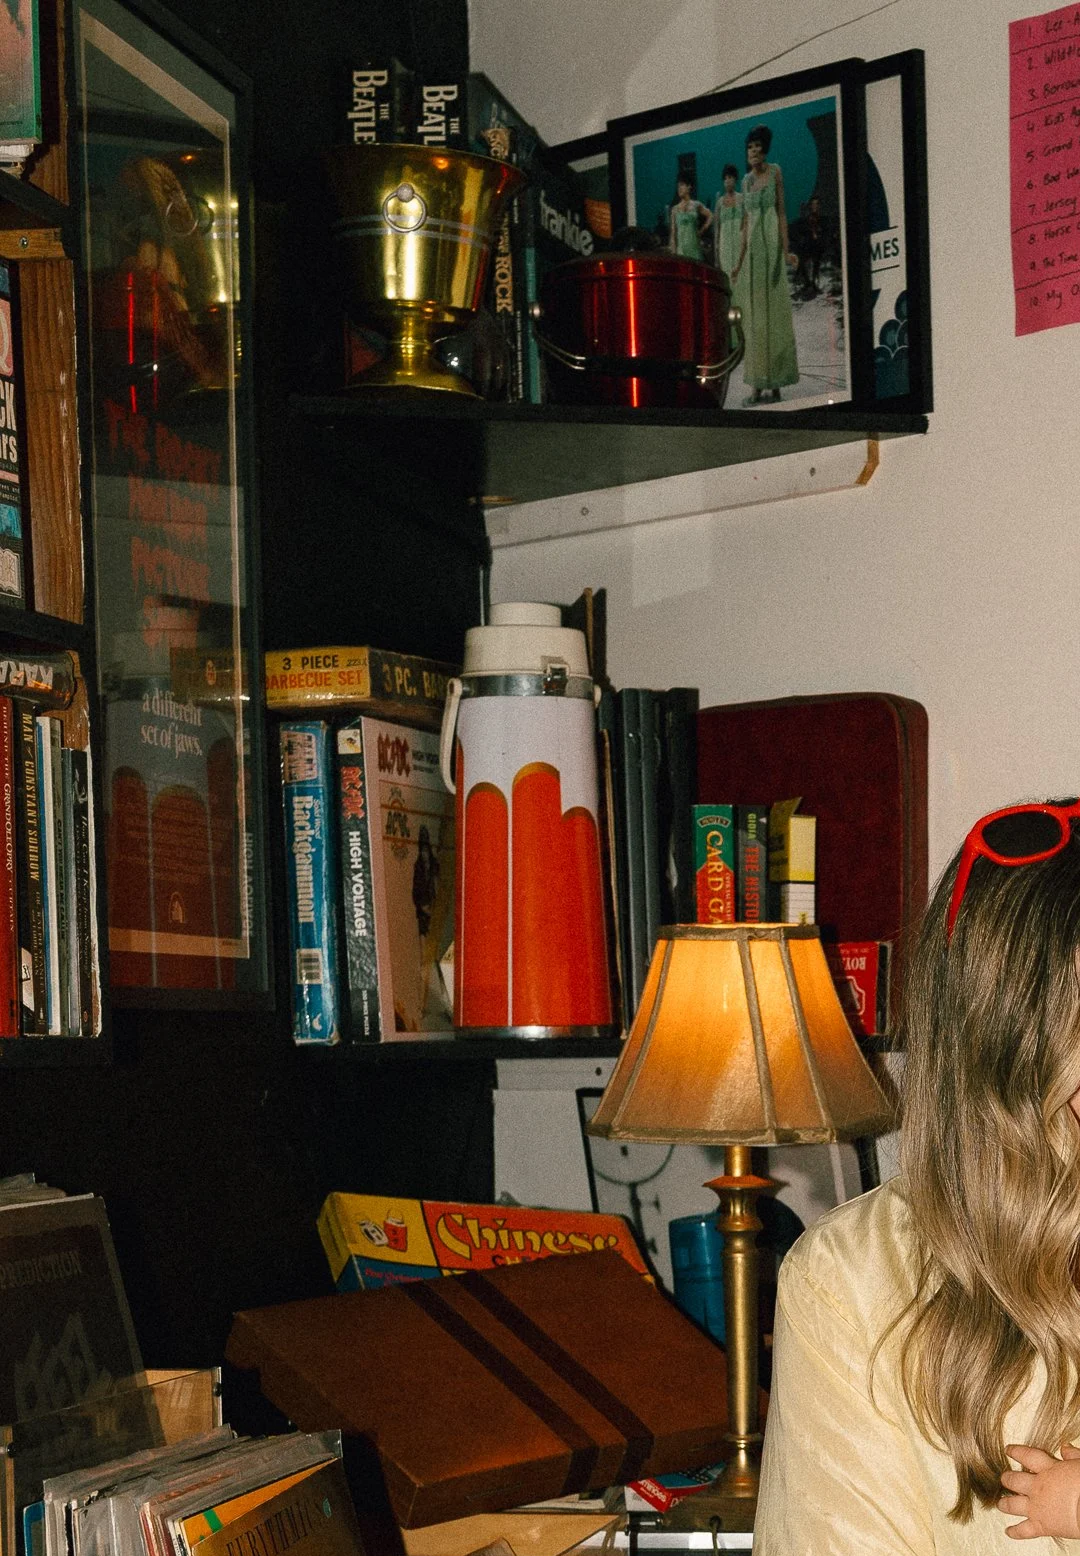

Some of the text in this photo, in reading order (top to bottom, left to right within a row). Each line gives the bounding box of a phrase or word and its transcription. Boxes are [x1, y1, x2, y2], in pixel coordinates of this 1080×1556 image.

[380, 103, 390, 120] THE
[450, 117, 461, 134] THE
[1043, 139, 1073, 158] Grand
[1043, 196, 1077, 216] Jersey
[1044, 225, 1072, 241] Horse
[1058, 252, 1078, 263] Time
[495, 254, 514, 314] ROCK
[1047, 290, 1063, 310] My
[282, 654, 340, 671] 3 PIECE
[265, 669, 364, 690] BARBECUE SET
[382, 663, 418, 697] 3 PC.
[151, 688, 202, 727] different
[140, 720, 203, 759] set of jaws.
[22, 713, 40, 881] MAN CONSTANT SORROW
[292, 795, 316, 923] Backgammon
[706, 830, 724, 892] CARD
[745, 847, 760, 873] THE
[348, 829, 368, 938] HIGH VOLTAGE
[436, 1213, 619, 1260] Chinese
